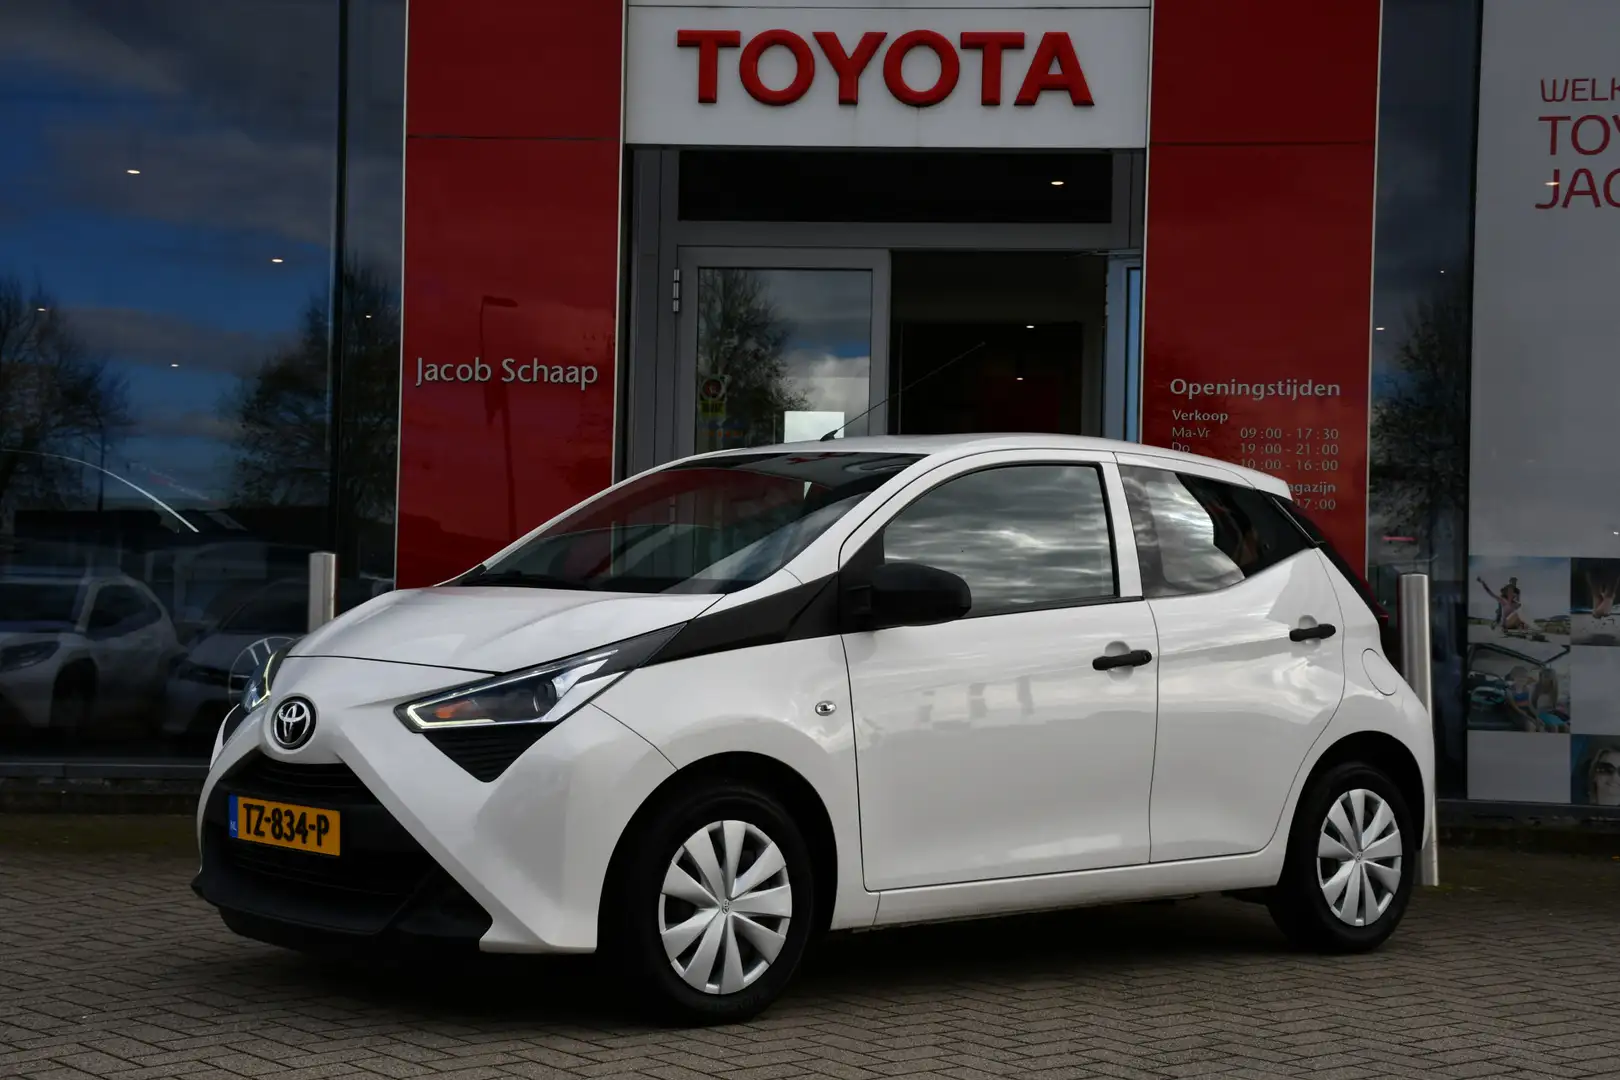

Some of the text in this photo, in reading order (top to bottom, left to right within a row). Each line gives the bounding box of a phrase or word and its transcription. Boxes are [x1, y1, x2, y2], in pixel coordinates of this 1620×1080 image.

[677, 29, 1095, 106] TOYOTA
[1538, 115, 1620, 156] TO
[415, 357, 598, 391] Jacob Schaap
[1170, 378, 1341, 401] Openingstijden
[1172, 409, 1229, 424] Verkoop
[1172, 427, 1210, 438] Ma-Vr
[1171, 441, 1190, 453] Do
[243, 803, 330, 847] TZ-834-P
